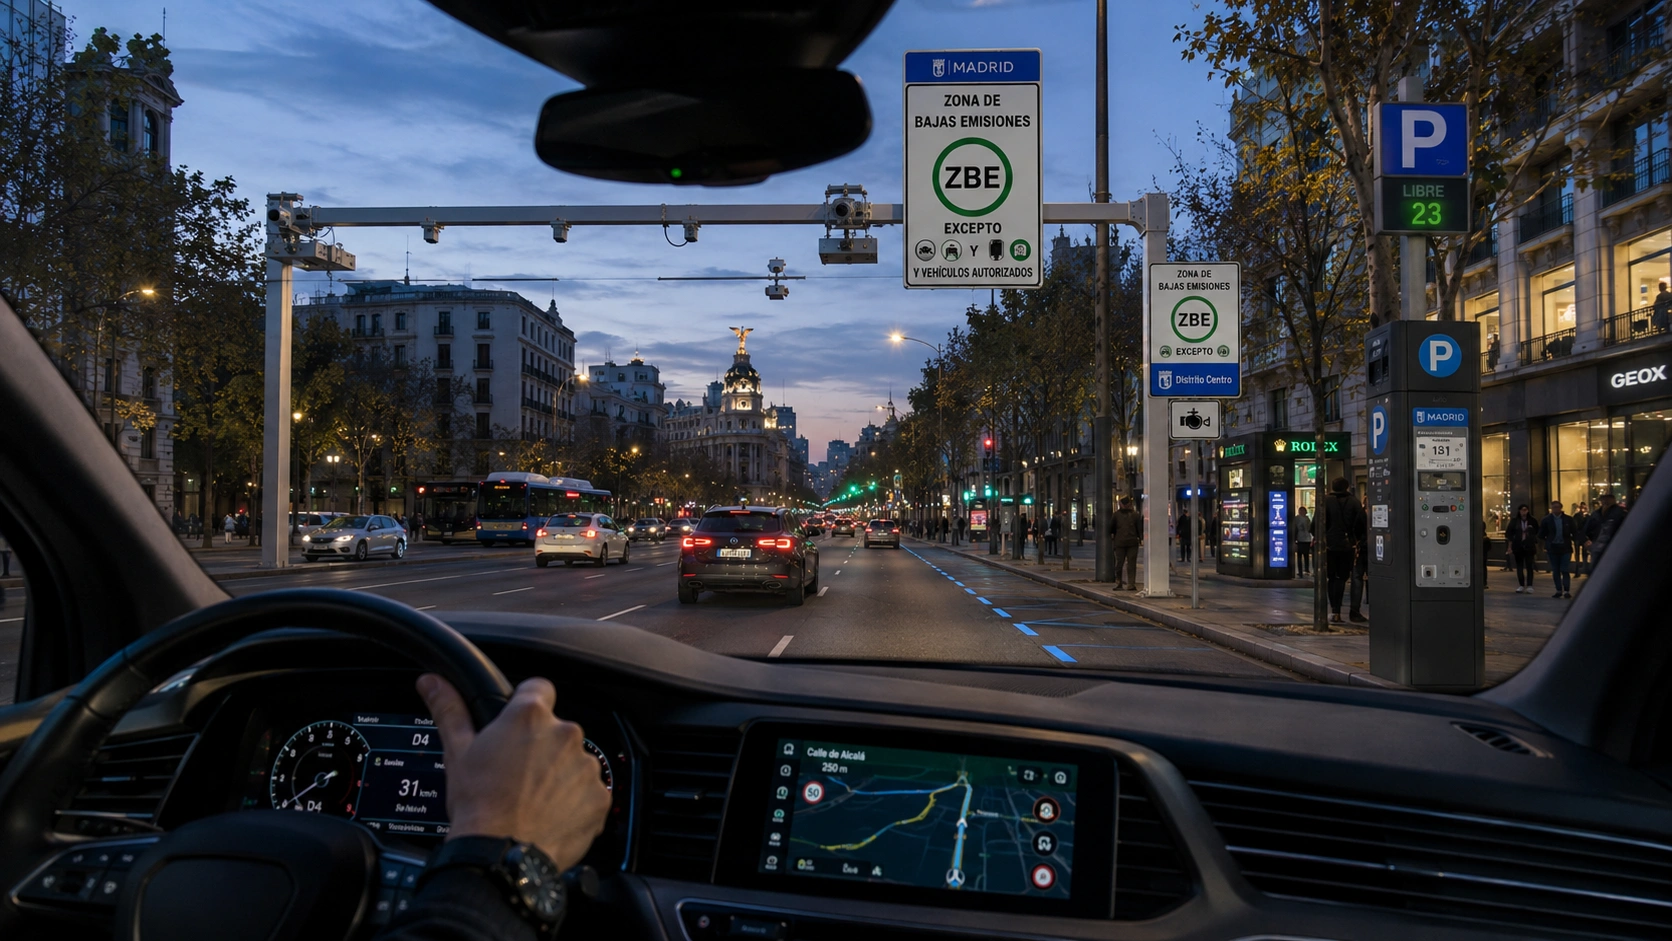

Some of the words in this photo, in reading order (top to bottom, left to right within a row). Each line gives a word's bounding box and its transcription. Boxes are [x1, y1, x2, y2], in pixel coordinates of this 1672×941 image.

[953, 61, 1014, 74] MADRID
[944, 94, 980, 107] ZONA
[984, 94, 1001, 106] DE
[914, 115, 957, 128] BAJAS
[960, 115, 1031, 127] EMISIONES
[1402, 109, 1447, 168] P
[945, 166, 1000, 189] ZBE
[1402, 184, 1444, 197] LIBRE
[1411, 202, 1442, 225] 23
[944, 222, 1002, 234] EXCEPTO
[969, 245, 979, 257] Y
[913, 267, 921, 278] Y
[921, 265, 970, 278] VEHÍCULOS
[971, 267, 1033, 278] AUTORIZADOS
[1177, 270, 1199, 279] ZONA
[1201, 270, 1212, 278] DE
[1158, 282, 1185, 291] BAJAS
[1187, 282, 1231, 291] EMISIONES
[1178, 312, 1211, 327] ZBE
[1176, 347, 1213, 356] EXCEPTO
[1429, 340, 1453, 371] P
[1206, 375, 1232, 384] Centro
[1611, 364, 1667, 388] GEOX
[1427, 413, 1465, 421] MADRID
[1373, 411, 1384, 449] P
[828, 749, 840, 759] de
[840, 750, 866, 761] Alcalá
[821, 762, 838, 773] 250
[839, 766, 848, 774] m
[398, 778, 420, 797] 31
[807, 787, 820, 798] 50
